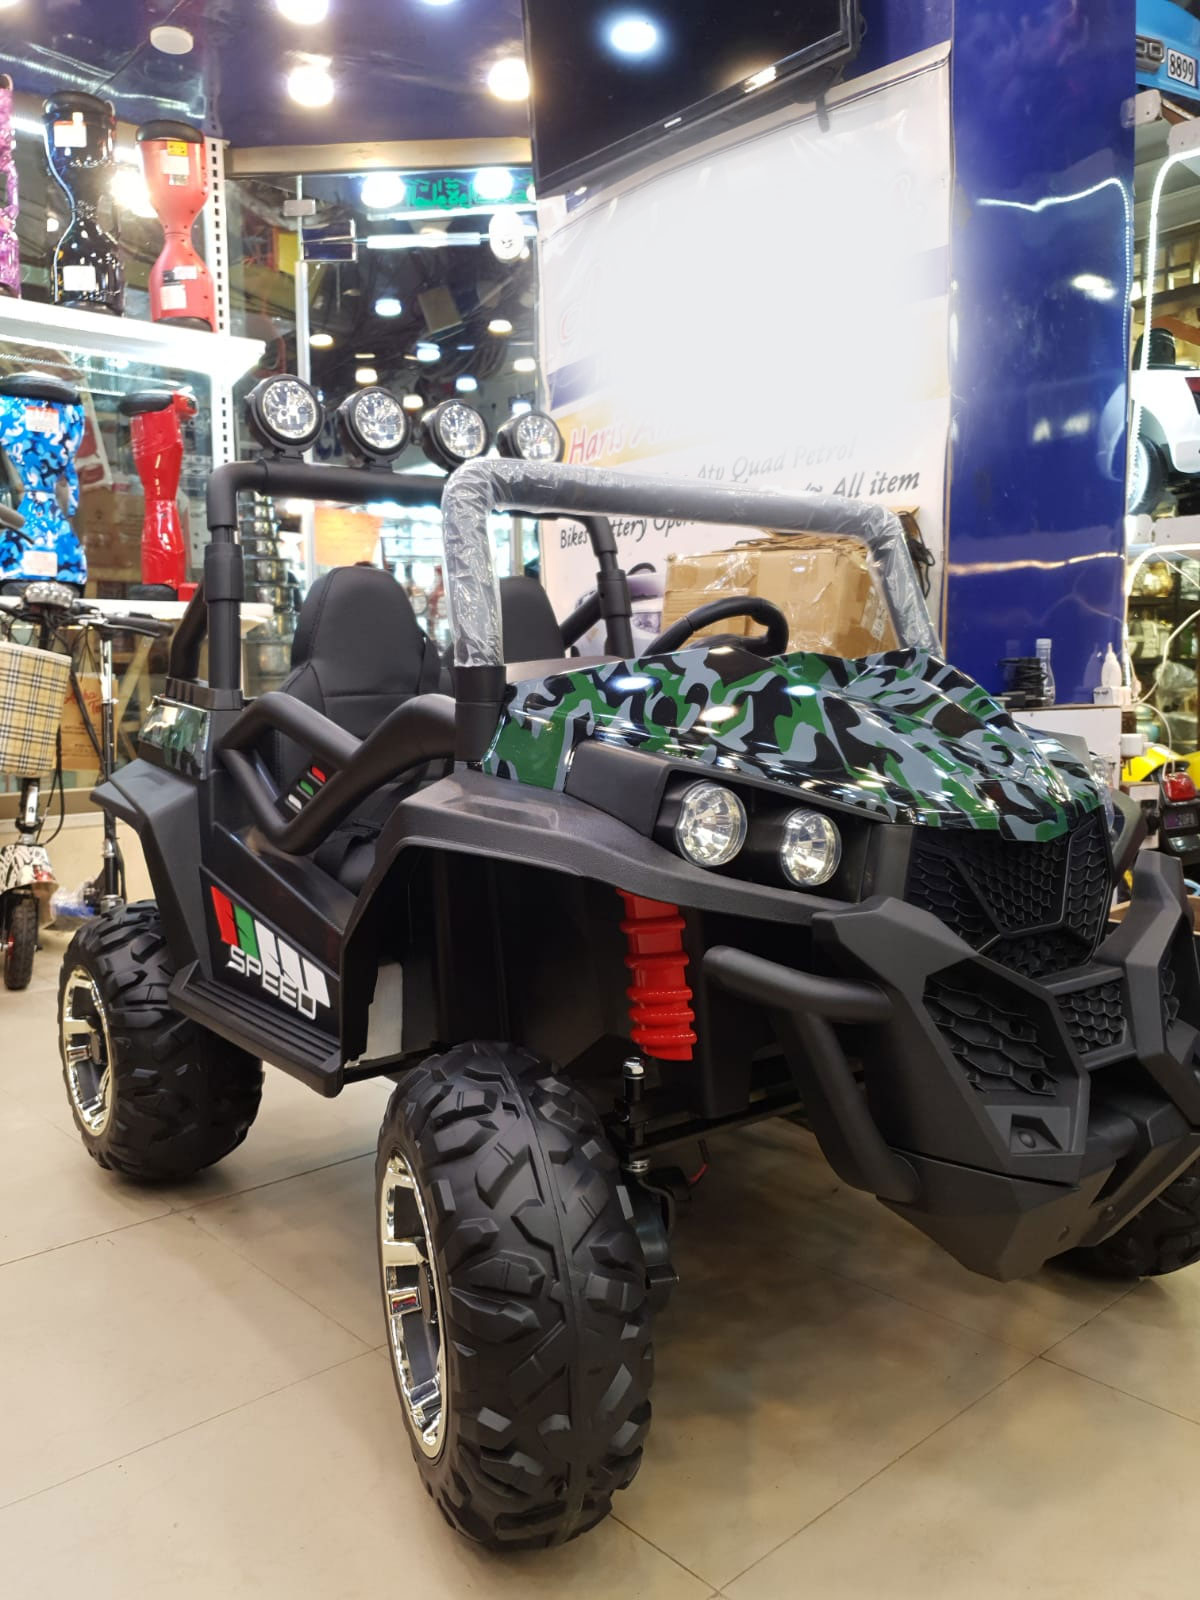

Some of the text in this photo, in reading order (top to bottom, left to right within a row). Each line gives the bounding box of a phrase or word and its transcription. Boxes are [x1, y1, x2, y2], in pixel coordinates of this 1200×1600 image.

[1170, 54, 1194, 82] 8899
[731, 453, 785, 480] Quad
[792, 440, 856, 469] Petrol
[832, 472, 866, 498] All
[869, 470, 921, 497] item
[559, 525, 588, 549] Bikes
[226, 943, 317, 1020] SPEED
